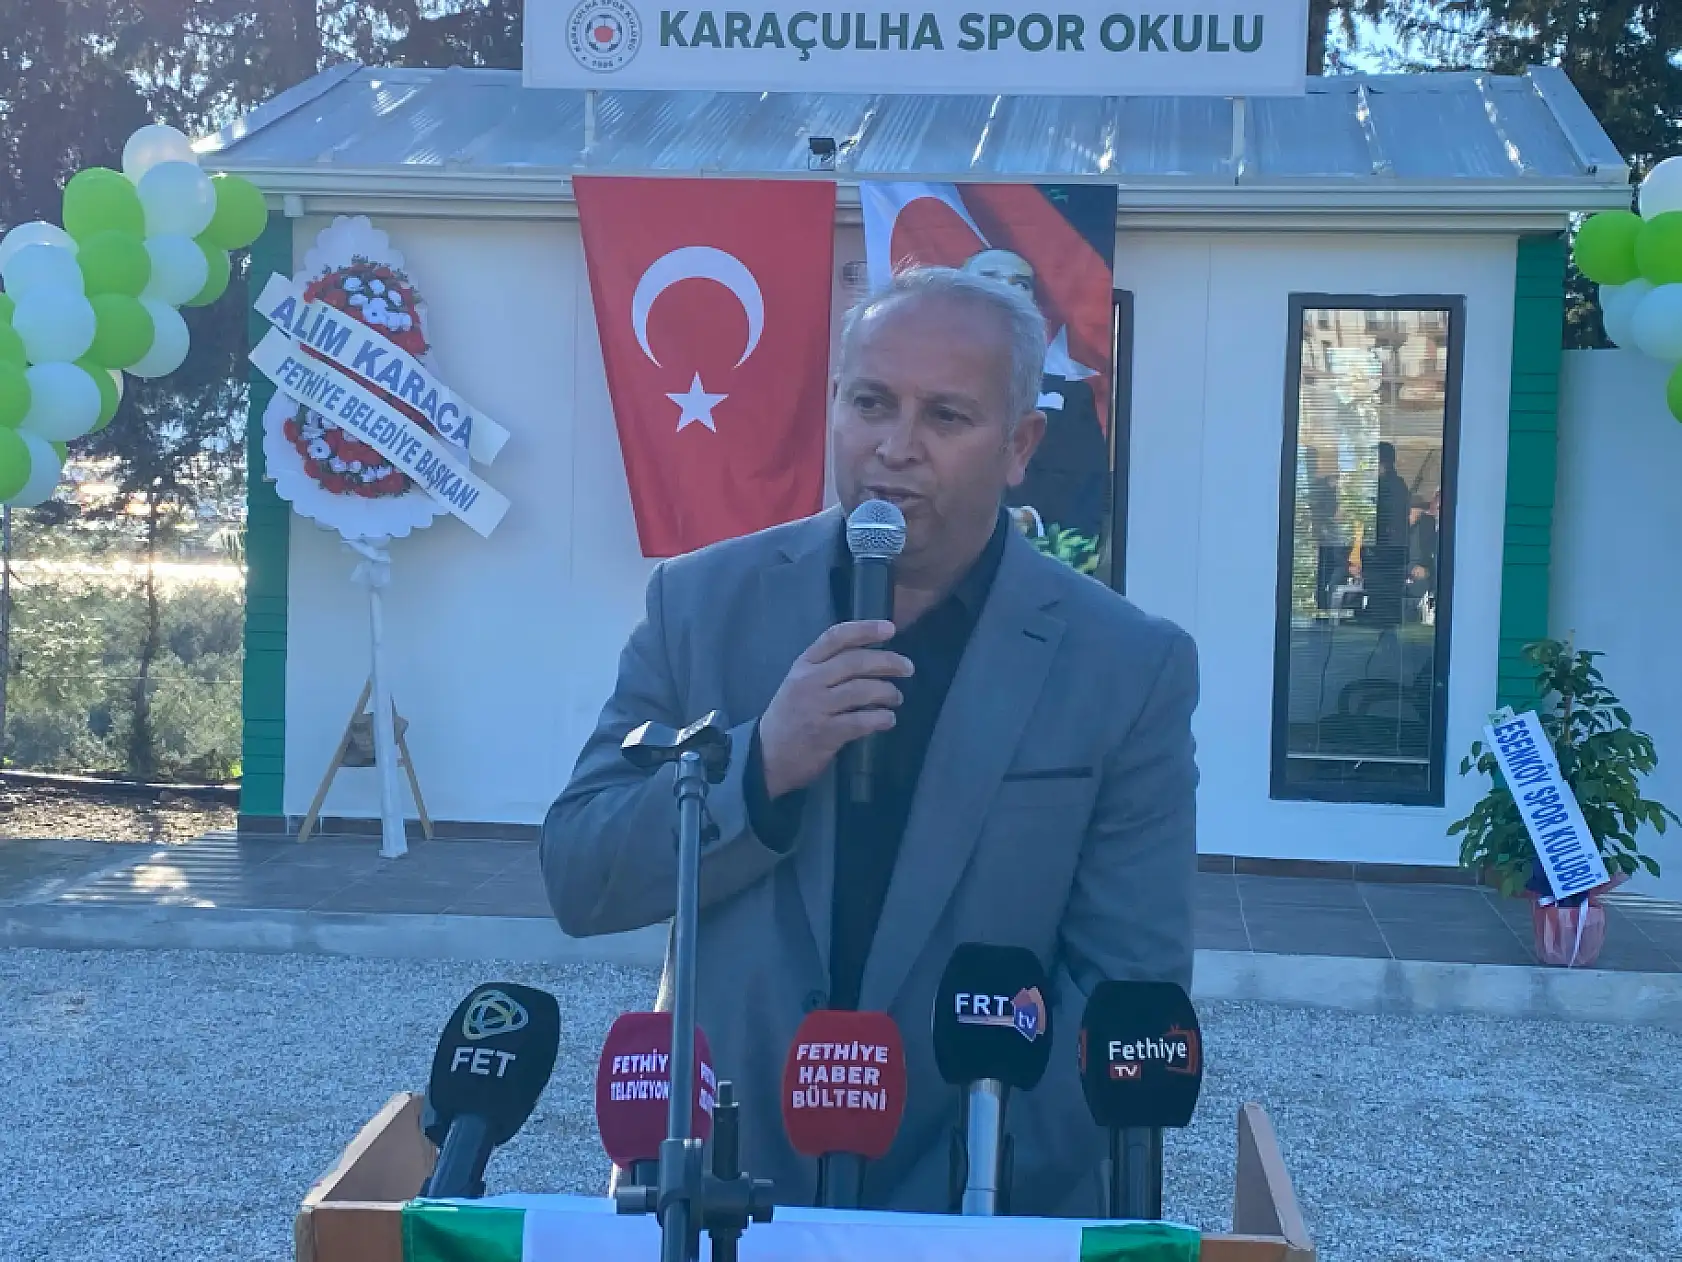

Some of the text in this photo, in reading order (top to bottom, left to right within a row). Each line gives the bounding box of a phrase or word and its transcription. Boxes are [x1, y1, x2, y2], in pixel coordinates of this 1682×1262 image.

[660, 10, 944, 61] KARAÇULHA
[957, 13, 1085, 51] SPOR
[1100, 13, 1264, 52] OKULU
[269, 296, 473, 449] ALİM KARACA
[276, 356, 479, 512] FETHİYE BELEDİYE BAŞKANI
[1493, 719, 1602, 891] ESENKÖY SPOR KULÜBÜ
[955, 993, 1037, 1029] FRT tv
[450, 1046, 516, 1077] FET
[612, 1048, 669, 1075] FETHİY
[797, 1040, 889, 1063] FETHİYE
[1108, 1037, 1188, 1064] Fethiye
[799, 1065, 880, 1085] HABER
[1114, 1065, 1138, 1077] TV
[792, 1085, 886, 1111] BÜLTENİ
